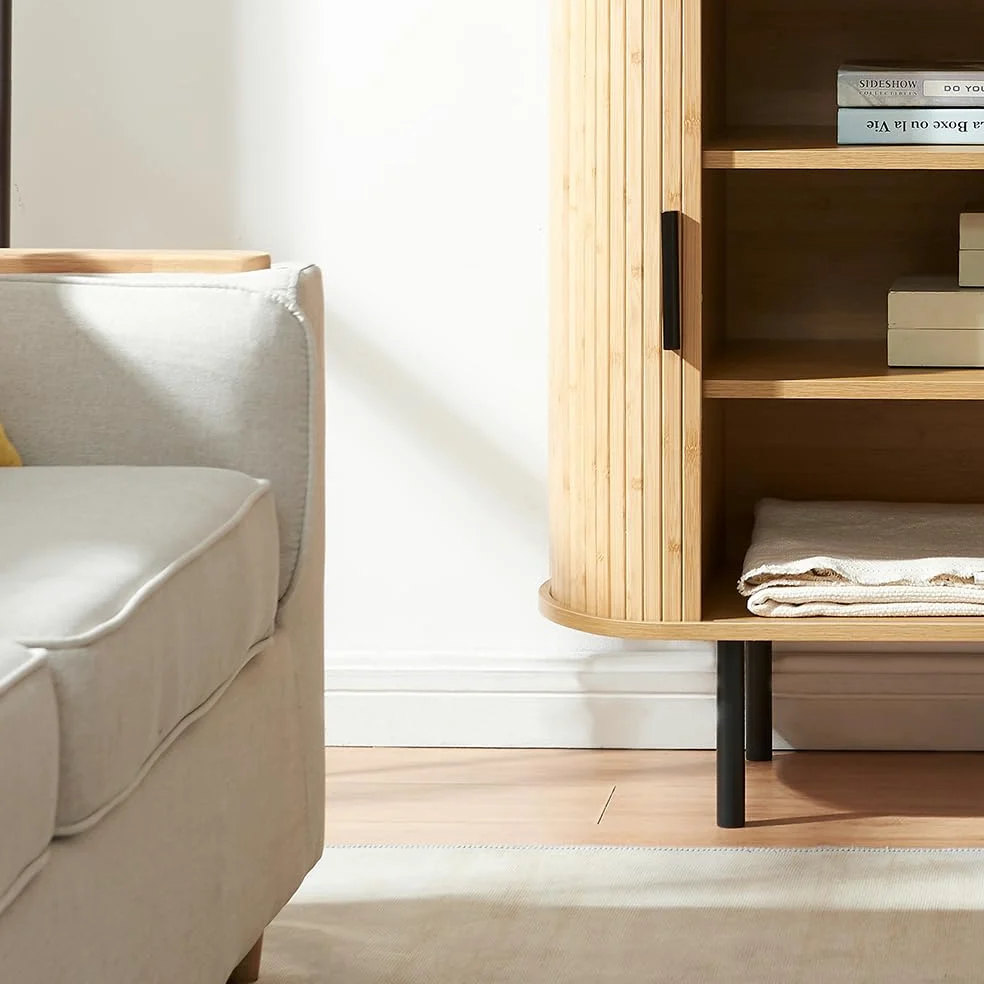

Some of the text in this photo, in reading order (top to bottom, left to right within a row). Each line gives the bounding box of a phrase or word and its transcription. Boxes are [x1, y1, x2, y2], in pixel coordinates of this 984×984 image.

[859, 79, 918, 89] SIDESHOW
[866, 120, 890, 133] Vie
[894, 120, 907, 132] la
[911, 121, 928, 129] ou
[933, 121, 968, 133] Boxe
